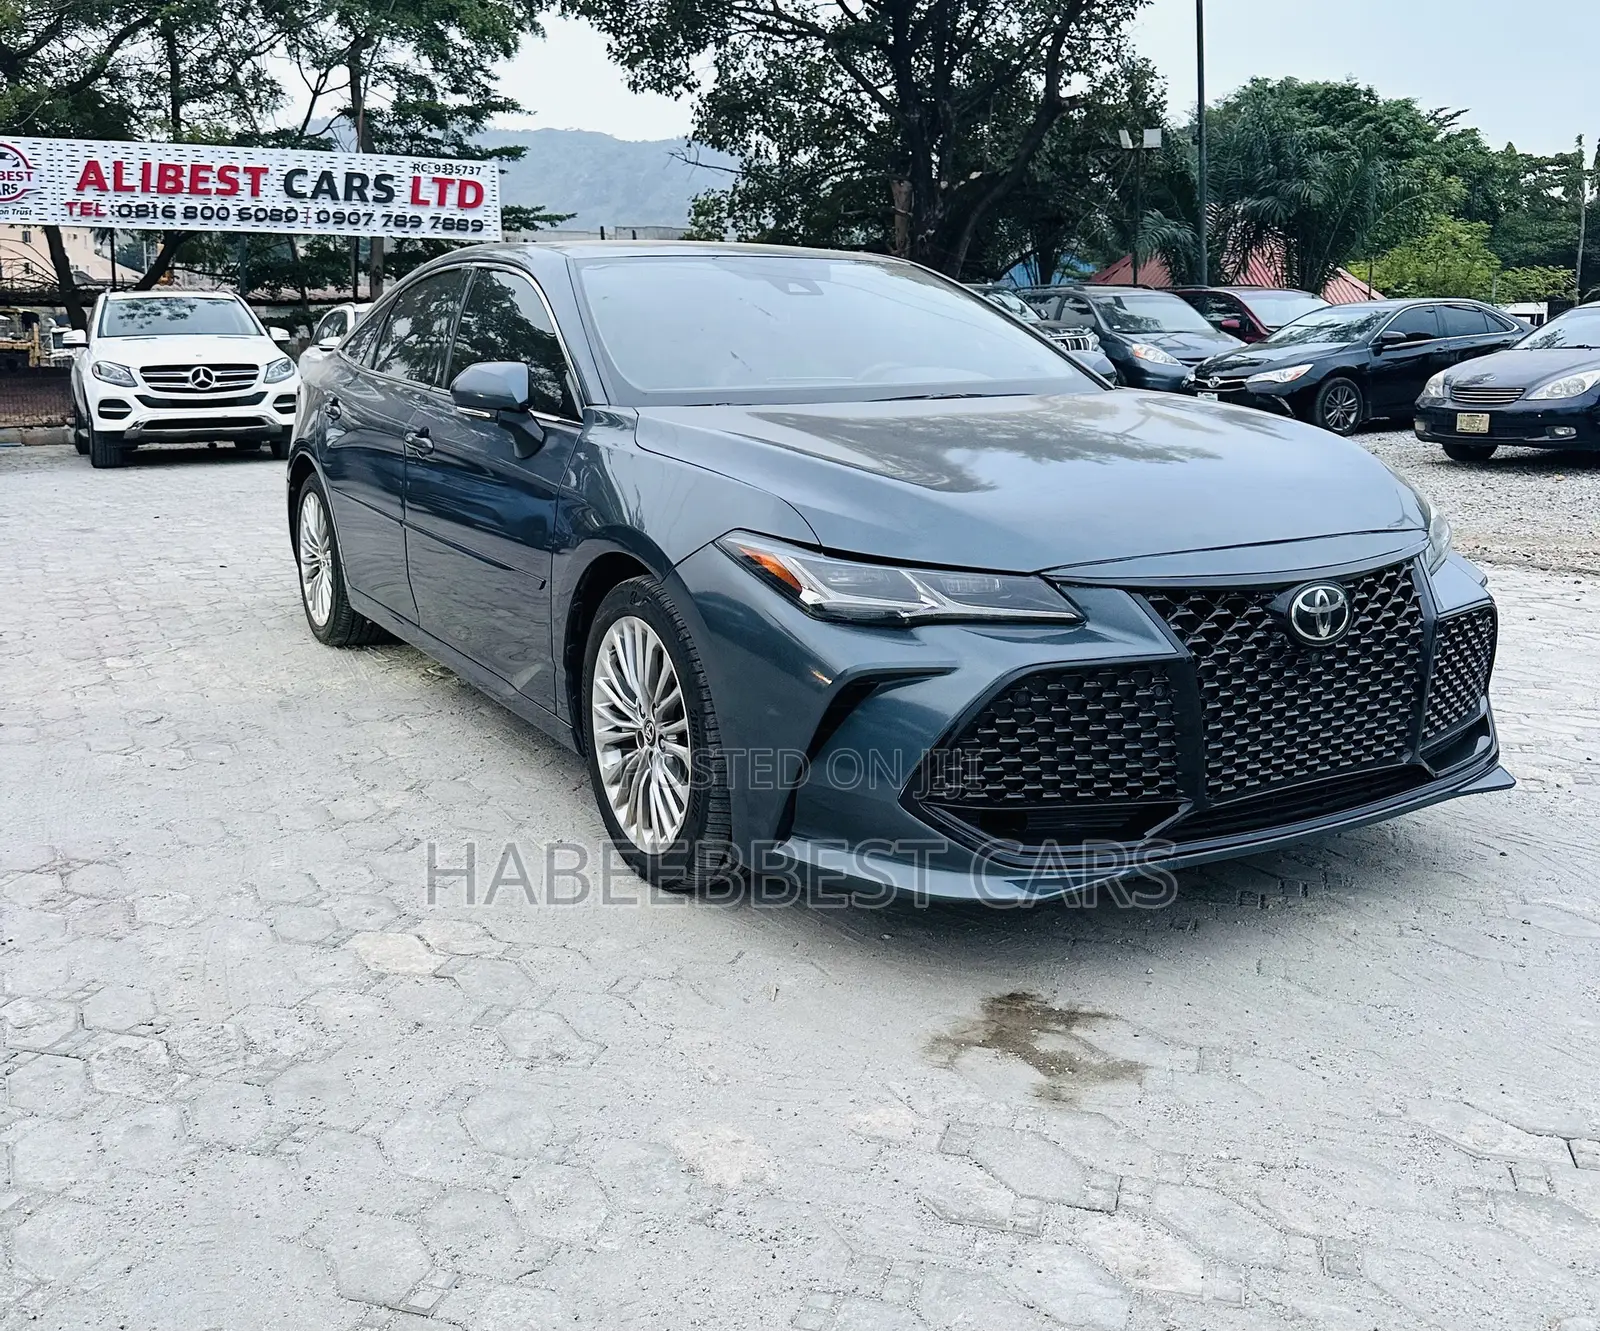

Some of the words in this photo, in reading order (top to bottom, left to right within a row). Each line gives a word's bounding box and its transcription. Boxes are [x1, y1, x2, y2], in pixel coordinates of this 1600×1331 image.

[75, 159, 269, 198] ALIBEST
[283, 167, 396, 204] CARS
[410, 175, 486, 209] LTD
[12, 208, 33, 216] Trust
[183, 205, 231, 221] 800
